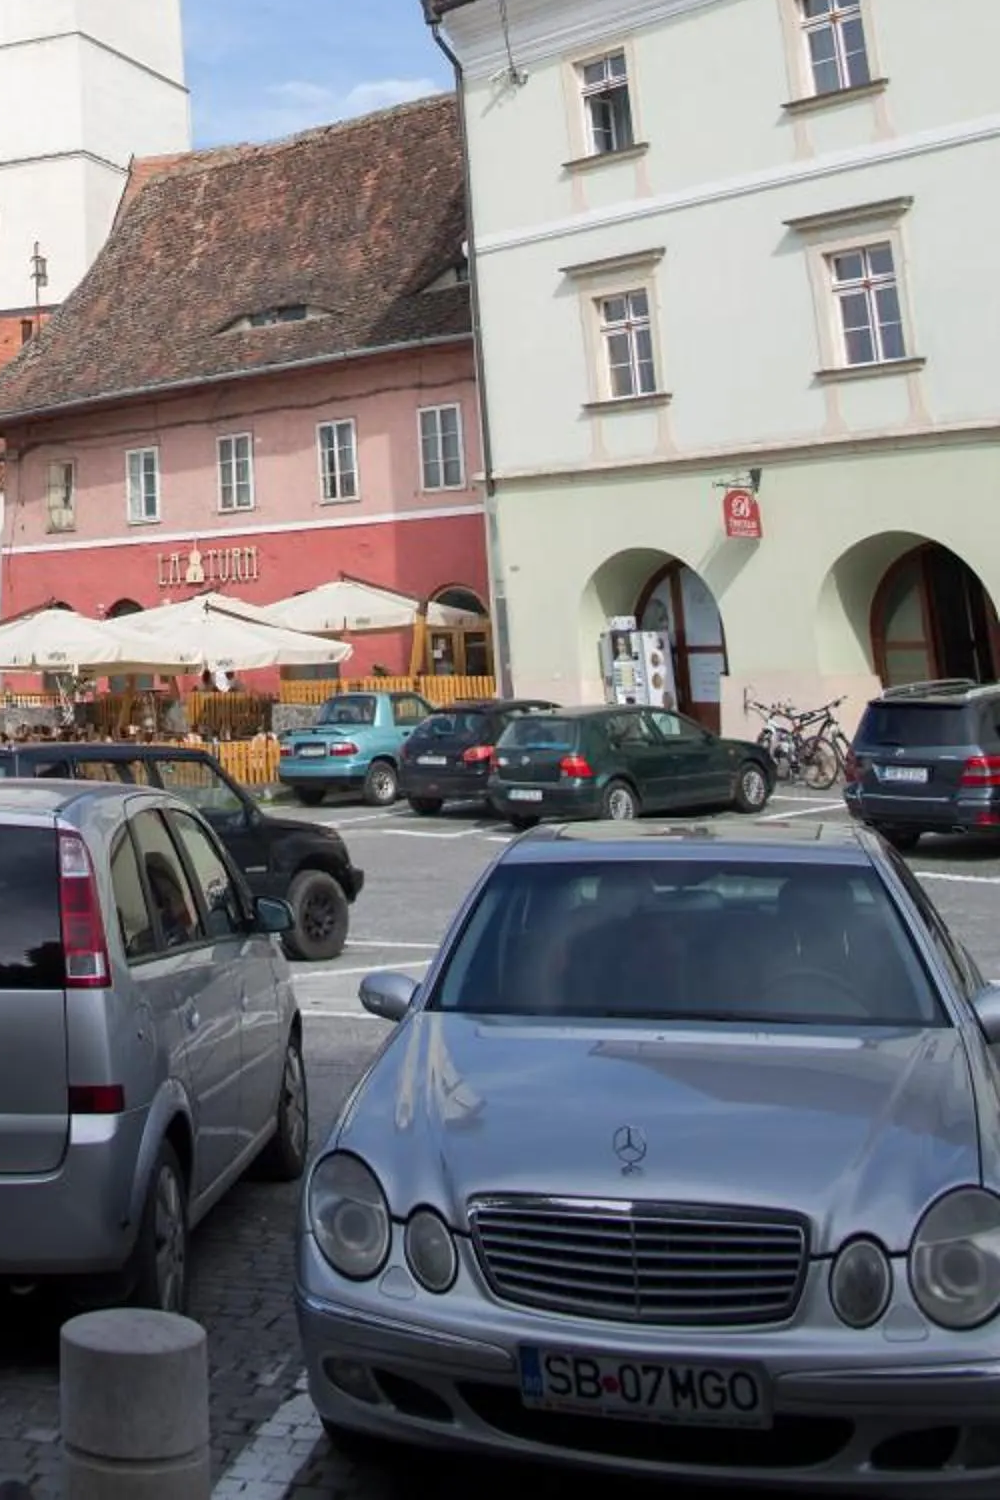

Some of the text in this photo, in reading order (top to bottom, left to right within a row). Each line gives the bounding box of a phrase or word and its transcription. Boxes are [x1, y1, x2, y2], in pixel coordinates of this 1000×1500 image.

[157, 546, 258, 585] LA TURN
[545, 1355, 760, 1411] SB 07MGO
